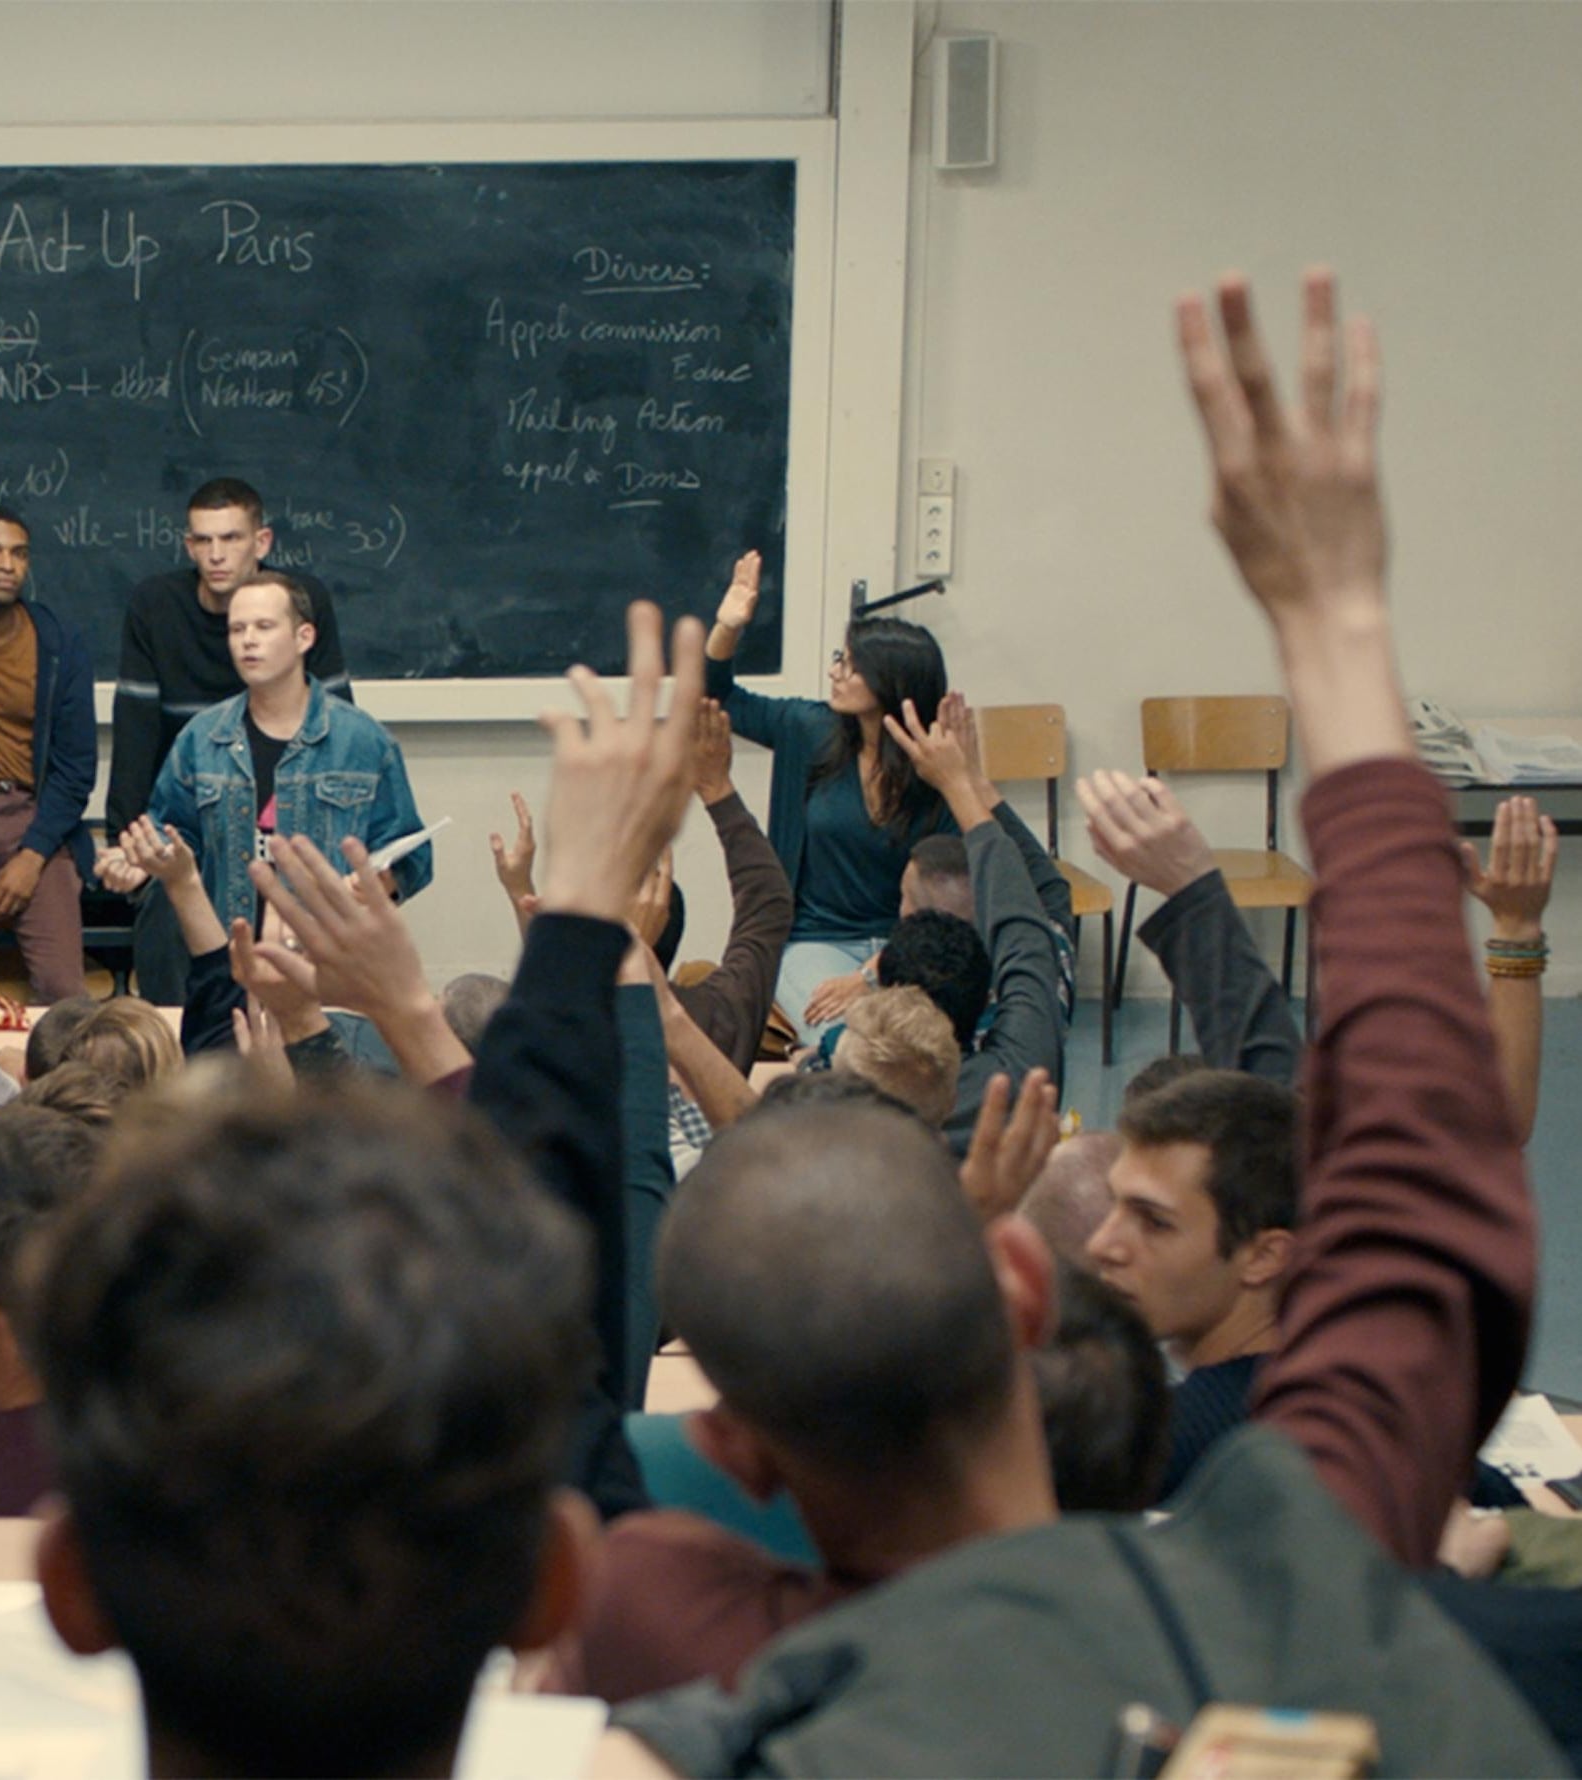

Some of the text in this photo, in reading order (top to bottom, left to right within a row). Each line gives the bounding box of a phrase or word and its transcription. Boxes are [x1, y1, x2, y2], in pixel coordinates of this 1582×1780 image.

[102, 208, 161, 300] Up
[200, 200, 314, 272] Paris
[580, 318, 721, 342] commission
[636, 398, 725, 432] Action
